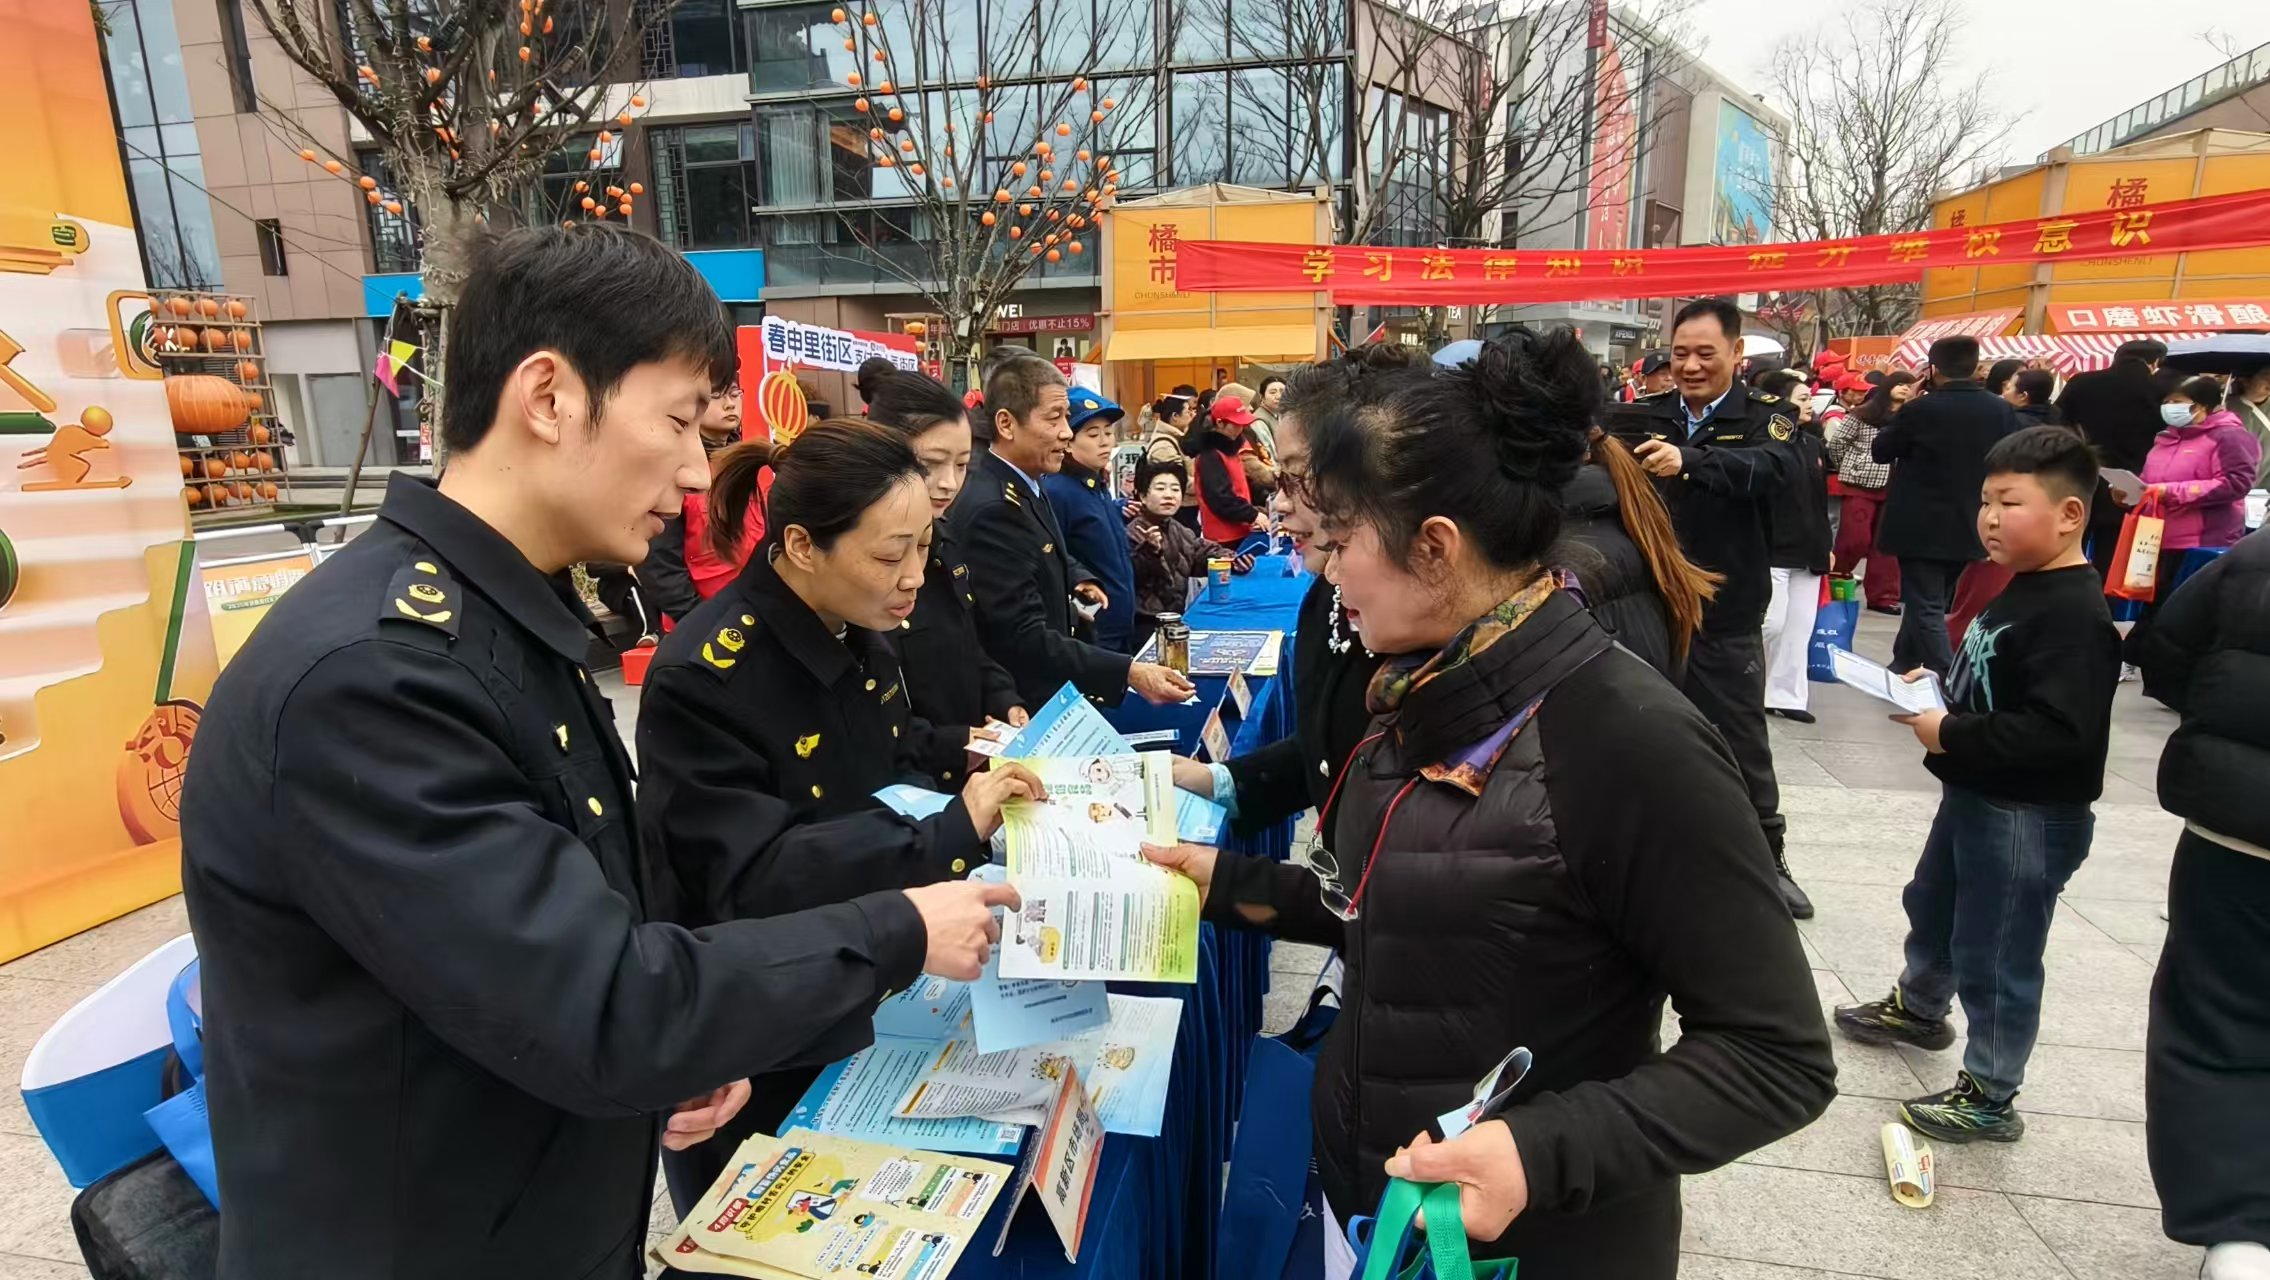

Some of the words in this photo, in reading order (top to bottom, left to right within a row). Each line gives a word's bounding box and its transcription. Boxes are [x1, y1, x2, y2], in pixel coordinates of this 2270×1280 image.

[1149, 223, 1181, 284] 橘市
[768, 323, 853, 366] 春申里街区
